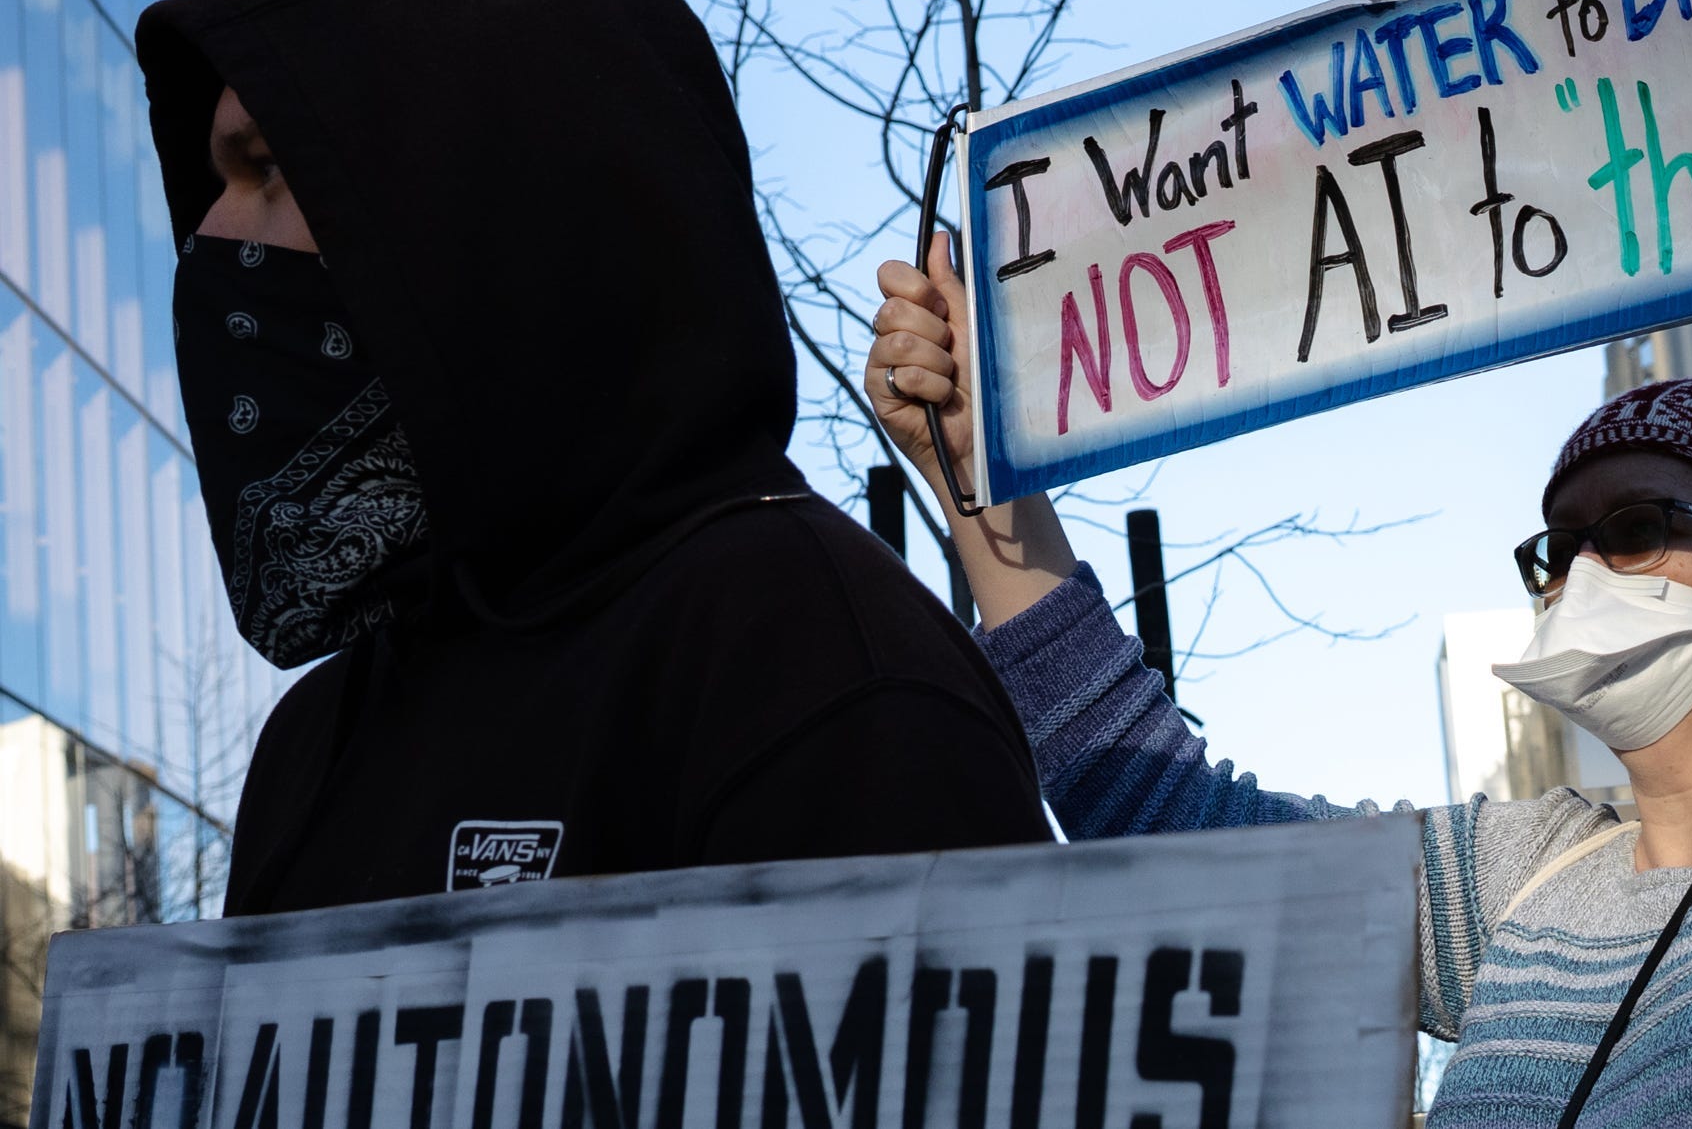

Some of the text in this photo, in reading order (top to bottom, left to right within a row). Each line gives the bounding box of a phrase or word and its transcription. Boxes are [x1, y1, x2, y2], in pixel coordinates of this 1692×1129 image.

[985, 156, 1056, 284] I
[1083, 78, 1259, 225] Want
[1057, 218, 1237, 436] NOT
[1297, 129, 1449, 364] AI
[1468, 107, 1570, 299] to
[471, 833, 541, 862] VANS
[234, 947, 1245, 1129] AUTONOMOUS
